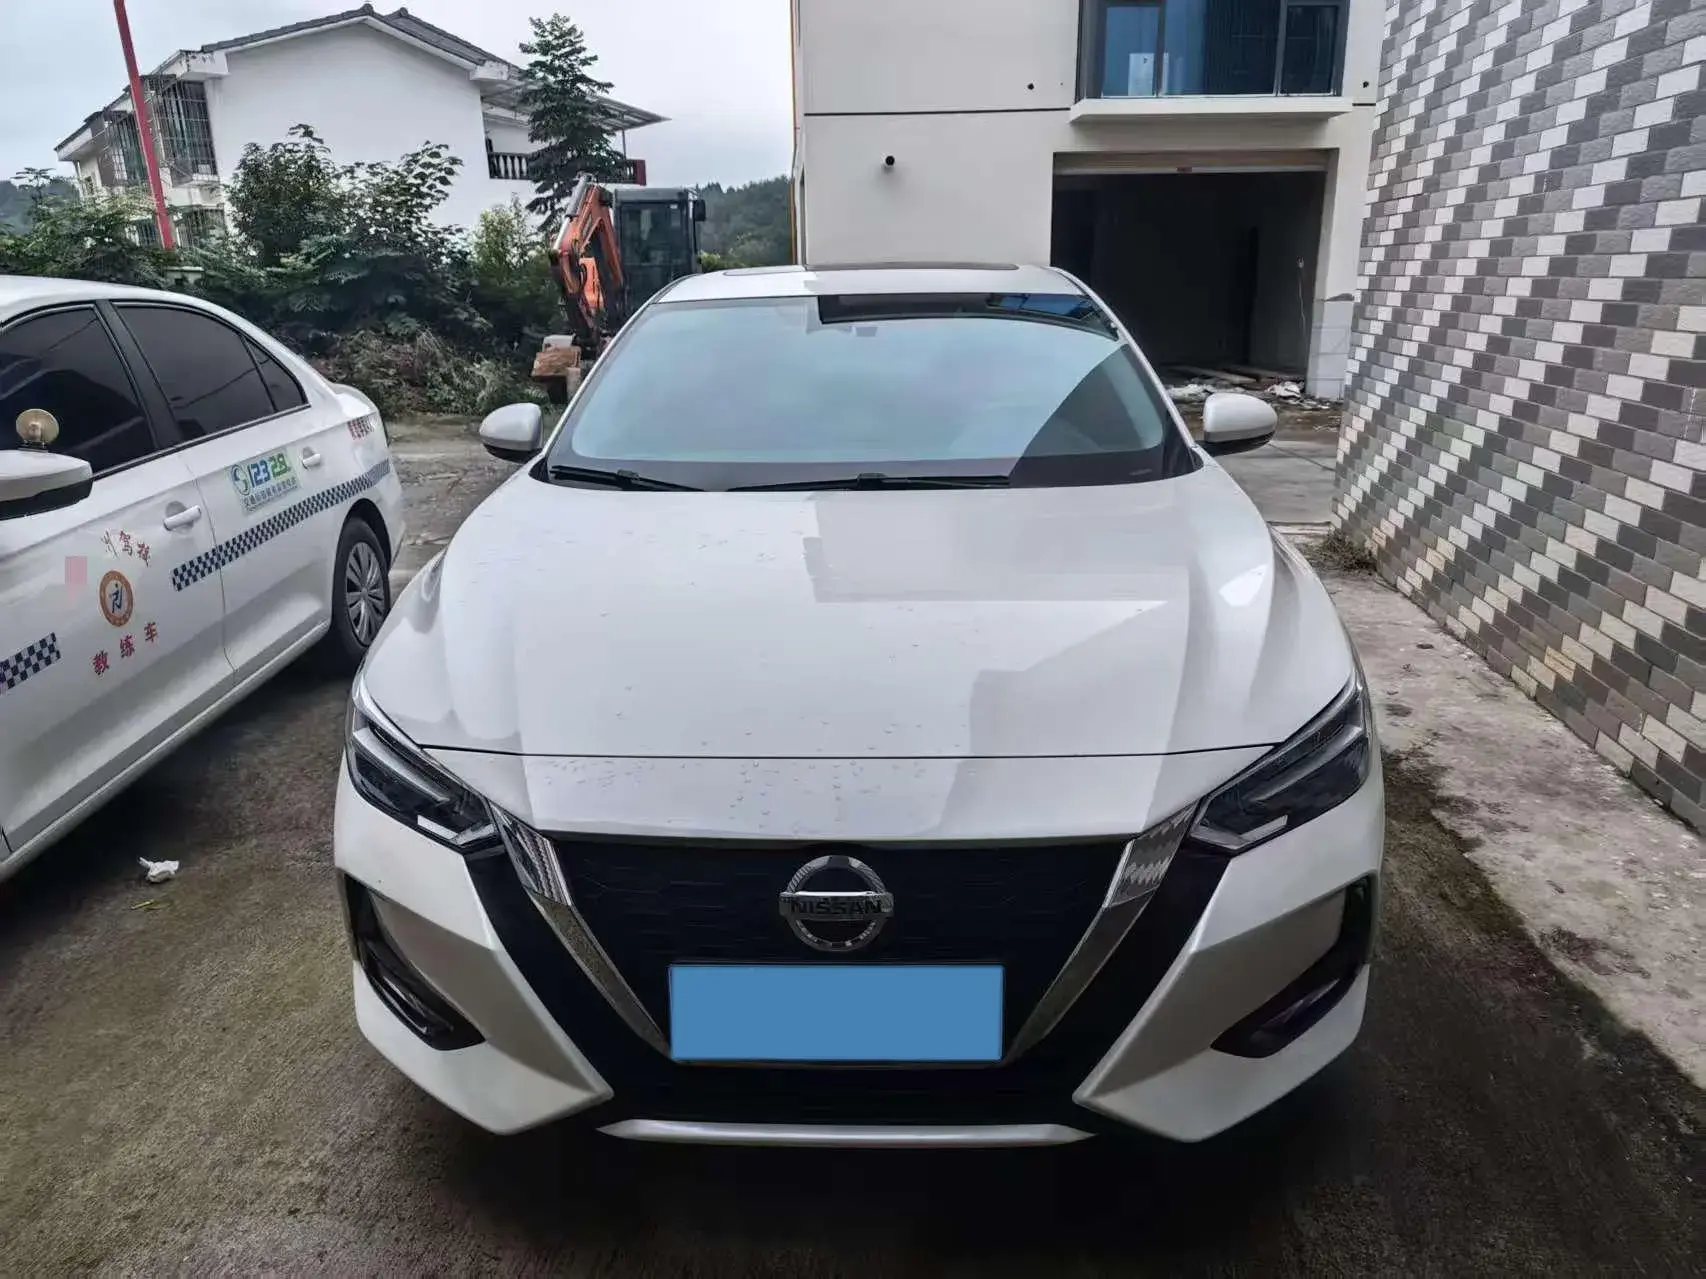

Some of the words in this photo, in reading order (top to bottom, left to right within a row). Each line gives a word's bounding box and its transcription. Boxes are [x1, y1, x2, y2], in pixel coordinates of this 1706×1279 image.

[93, 621, 158, 676] 教练车
[790, 898, 881, 914] NISSAN
